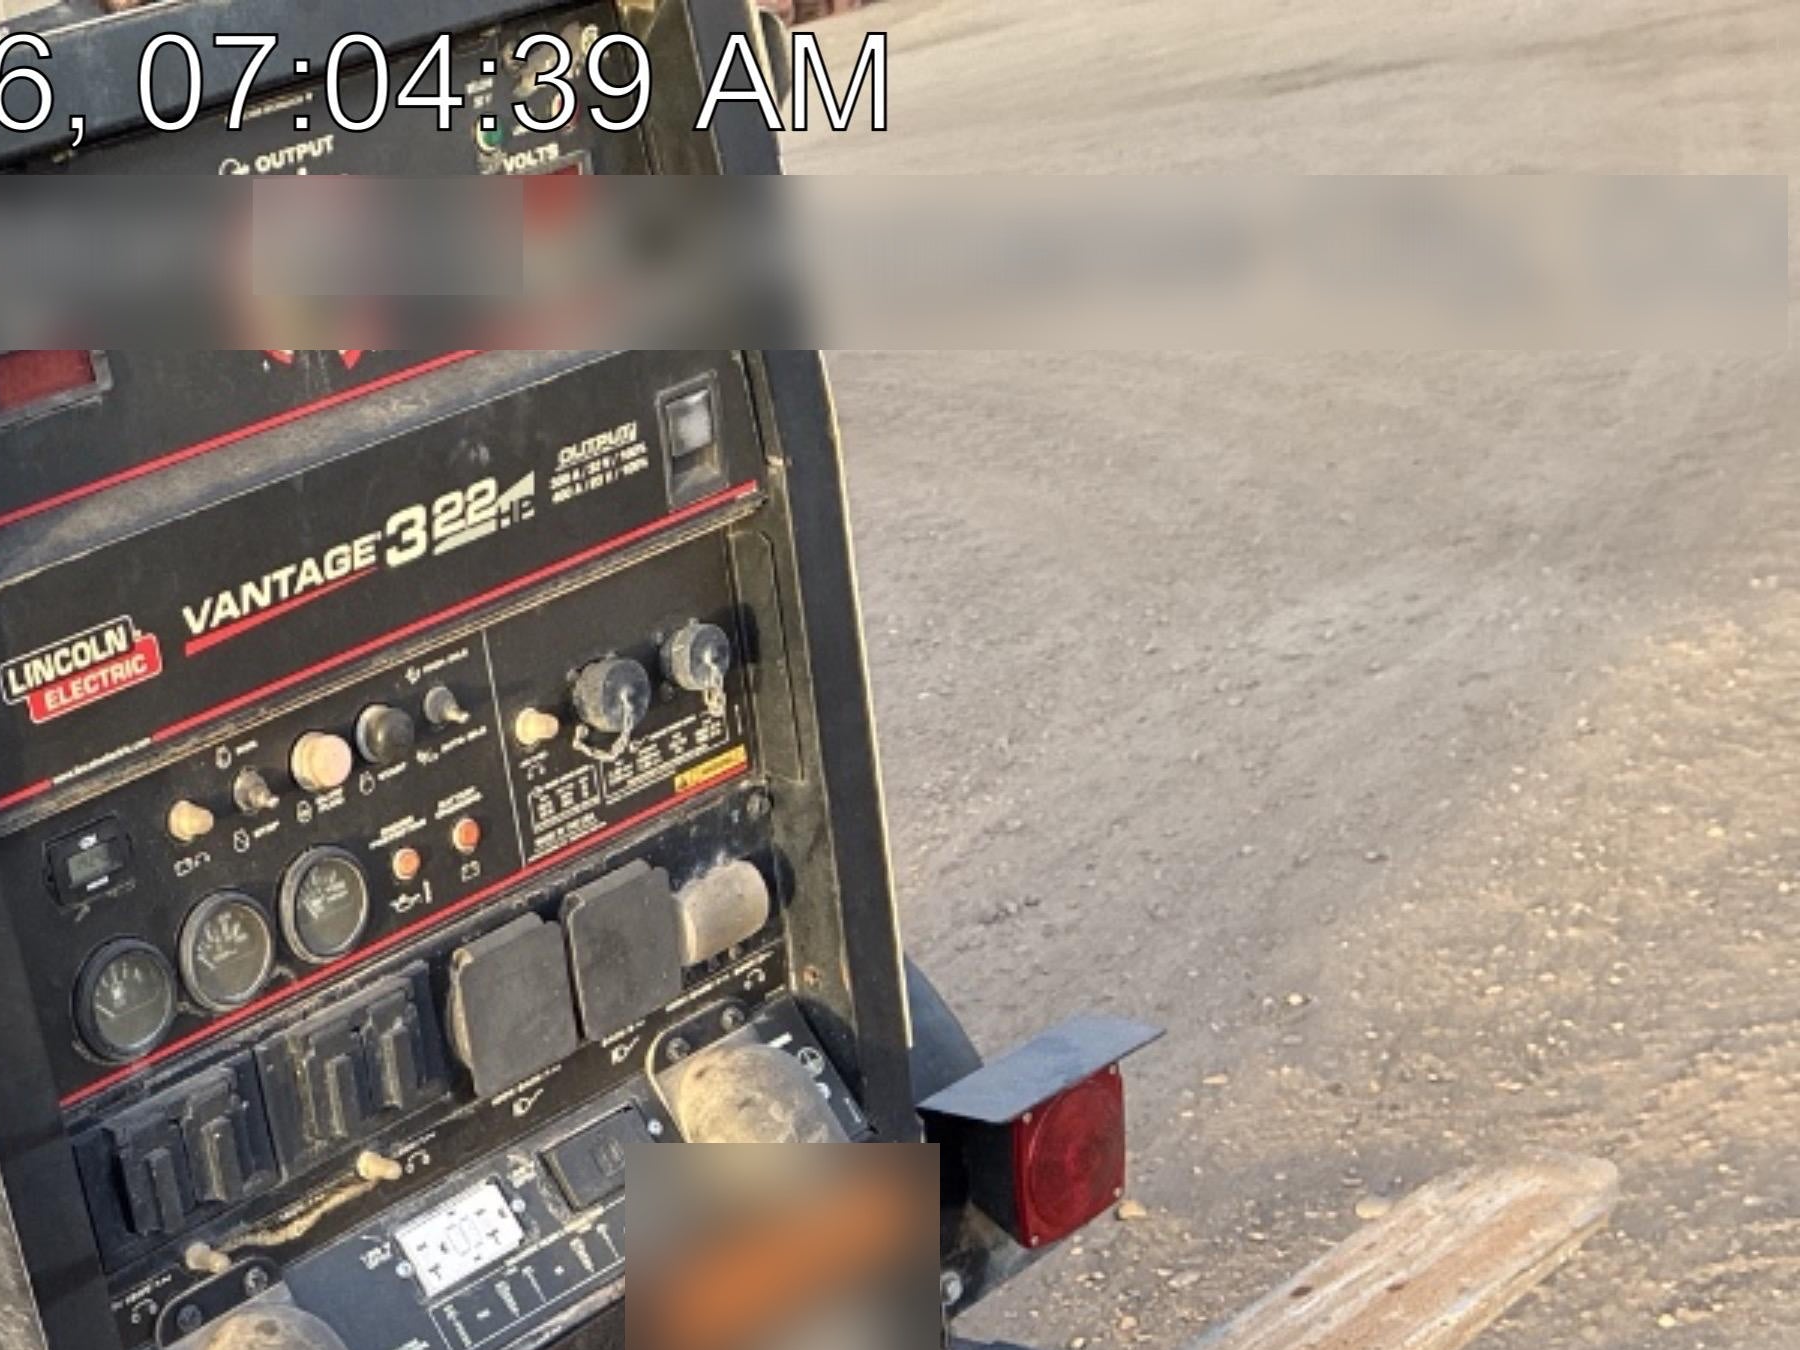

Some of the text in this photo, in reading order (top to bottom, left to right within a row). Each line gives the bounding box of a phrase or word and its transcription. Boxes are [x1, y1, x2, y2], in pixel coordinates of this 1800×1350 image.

[253, 132, 336, 175] OUTPUT
[502, 141, 561, 173] VOLTS
[183, 530, 382, 635] VANTAGE
[385, 476, 498, 568] 322
[7, 623, 130, 695] LINCOLN
[45, 653, 149, 711] ELECTRIC
